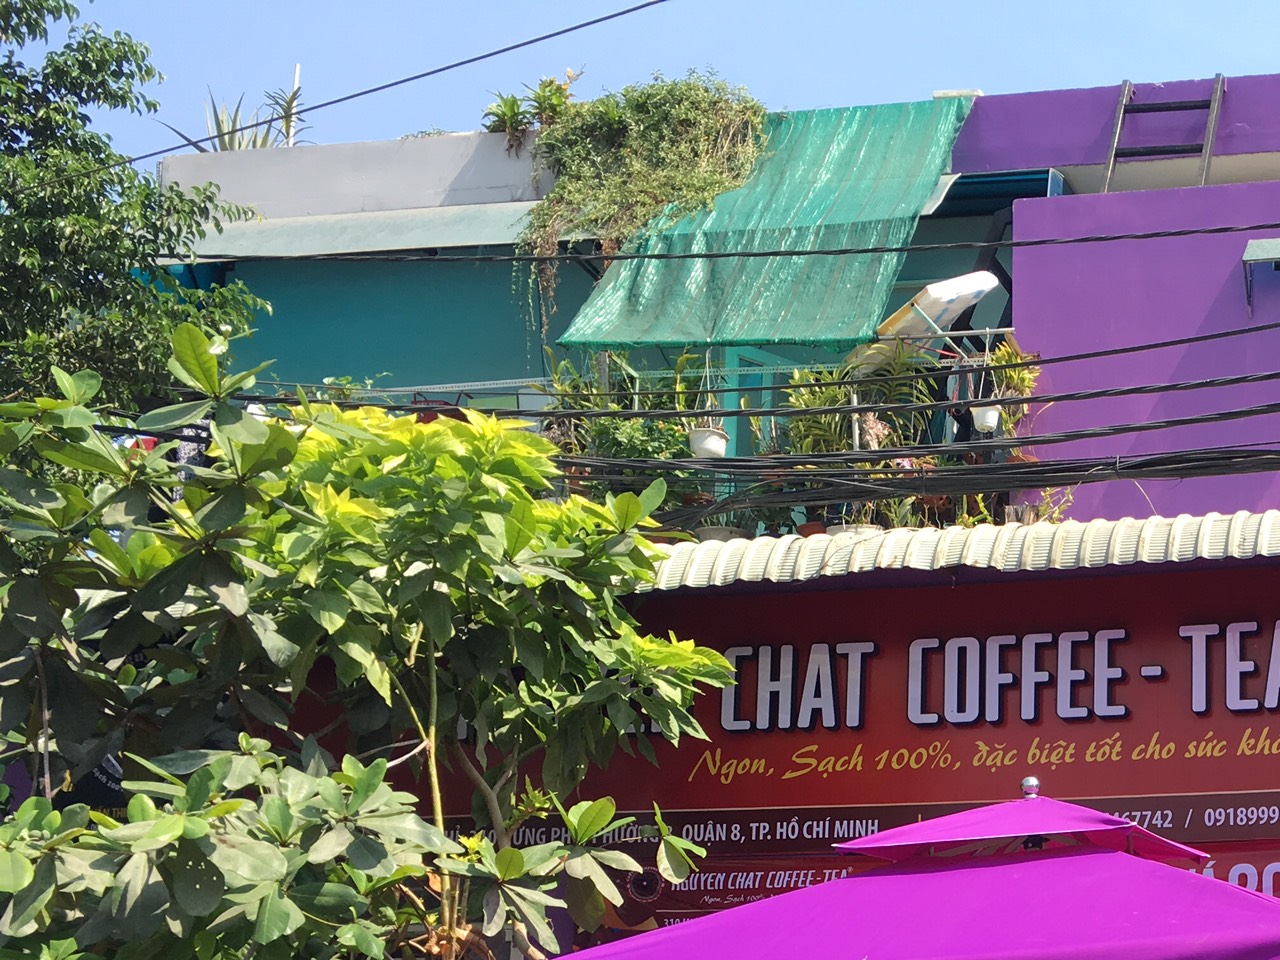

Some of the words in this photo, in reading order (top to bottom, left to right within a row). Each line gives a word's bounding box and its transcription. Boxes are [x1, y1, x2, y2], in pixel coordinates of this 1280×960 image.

[720, 640, 876, 732] CHAT
[907, 628, 1127, 724] COFFEE
[688, 747, 775, 785] Ngon,
[781, 743, 864, 780] Sạch
[874, 739, 961, 772] 100%,
[971, 740, 1018, 773] đặc
[1026, 736, 1076, 771] biệt
[1085, 731, 1122, 763] tốt
[1131, 730, 1176, 761] cho
[1187, 730, 1228, 759] sức
[682, 820, 727, 846] QUẬN
[730, 823, 746, 844] 8,
[750, 822, 772, 841] TP.
[776, 816, 799, 840] HỒ
[802, 816, 831, 839] CHÍ
[833, 819, 879, 838] MINH
[727, 870, 764, 890] CHAT
